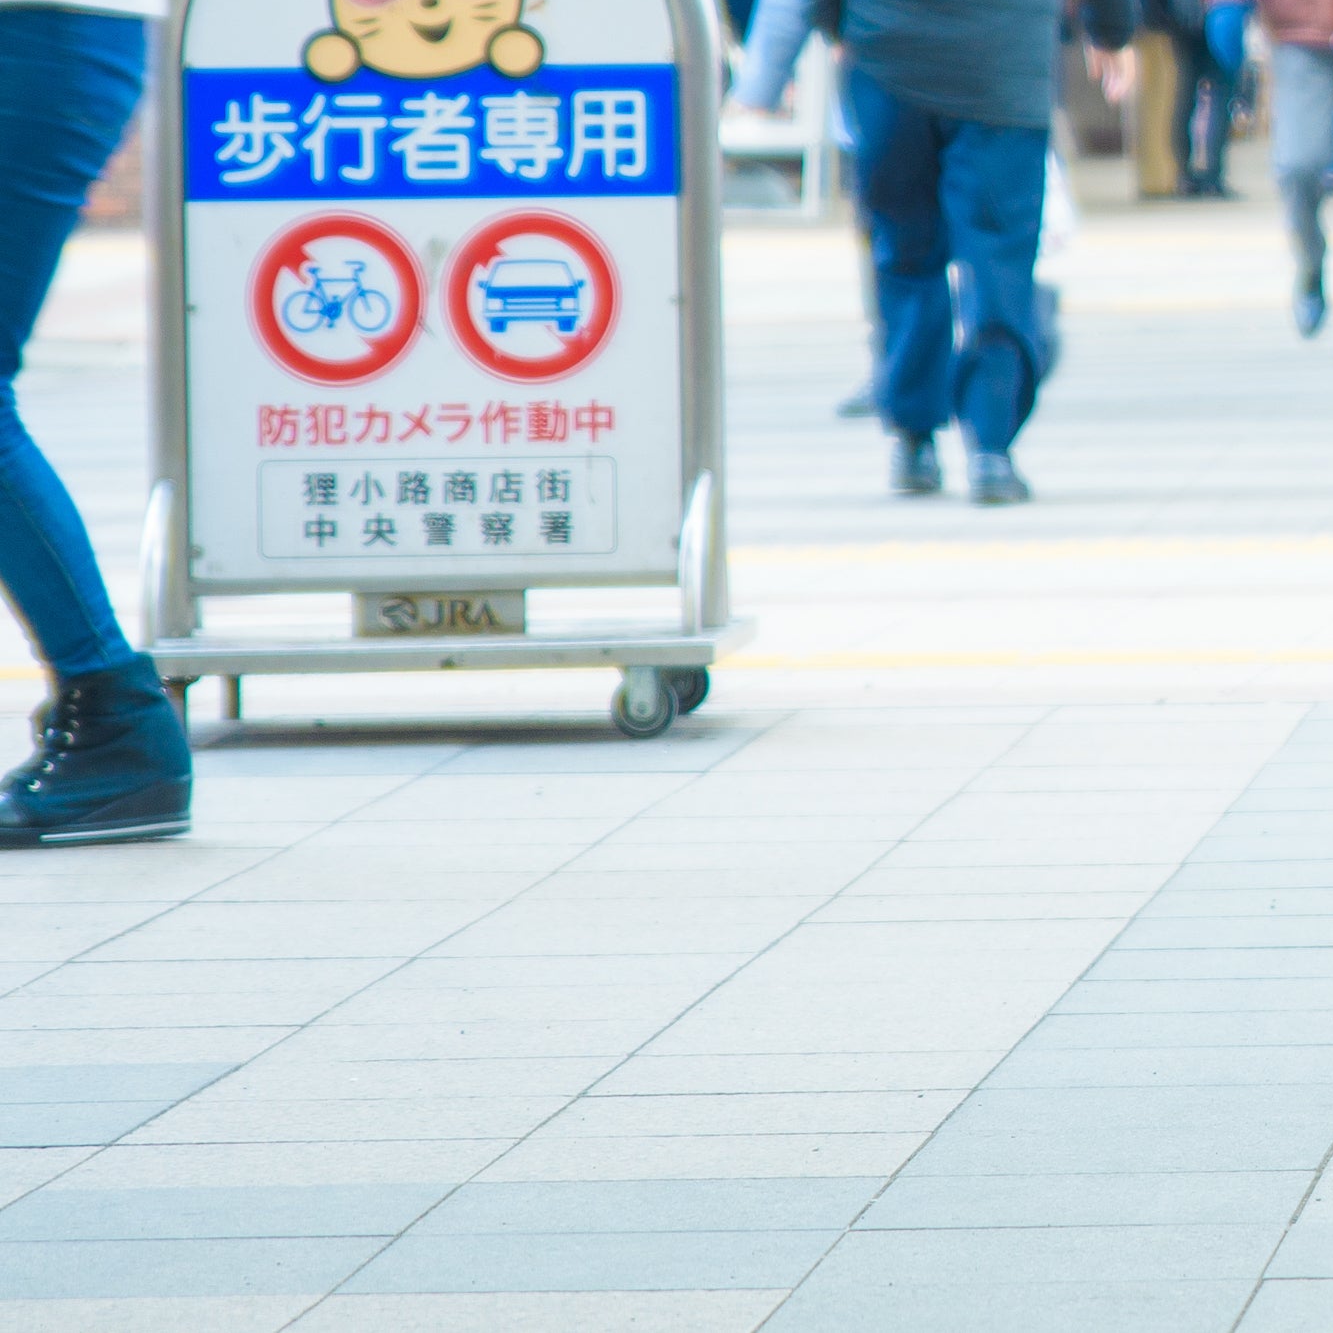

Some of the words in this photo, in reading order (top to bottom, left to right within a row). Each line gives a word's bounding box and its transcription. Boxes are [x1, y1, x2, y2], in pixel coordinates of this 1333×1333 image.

[213, 90, 648, 182] 歩行者専用
[256, 399, 616, 447] 防犯カメラ作動中
[302, 469, 572, 507] 狸小路商店街
[303, 510, 575, 548] 中央警察署
[427, 600, 499, 627] JRA
